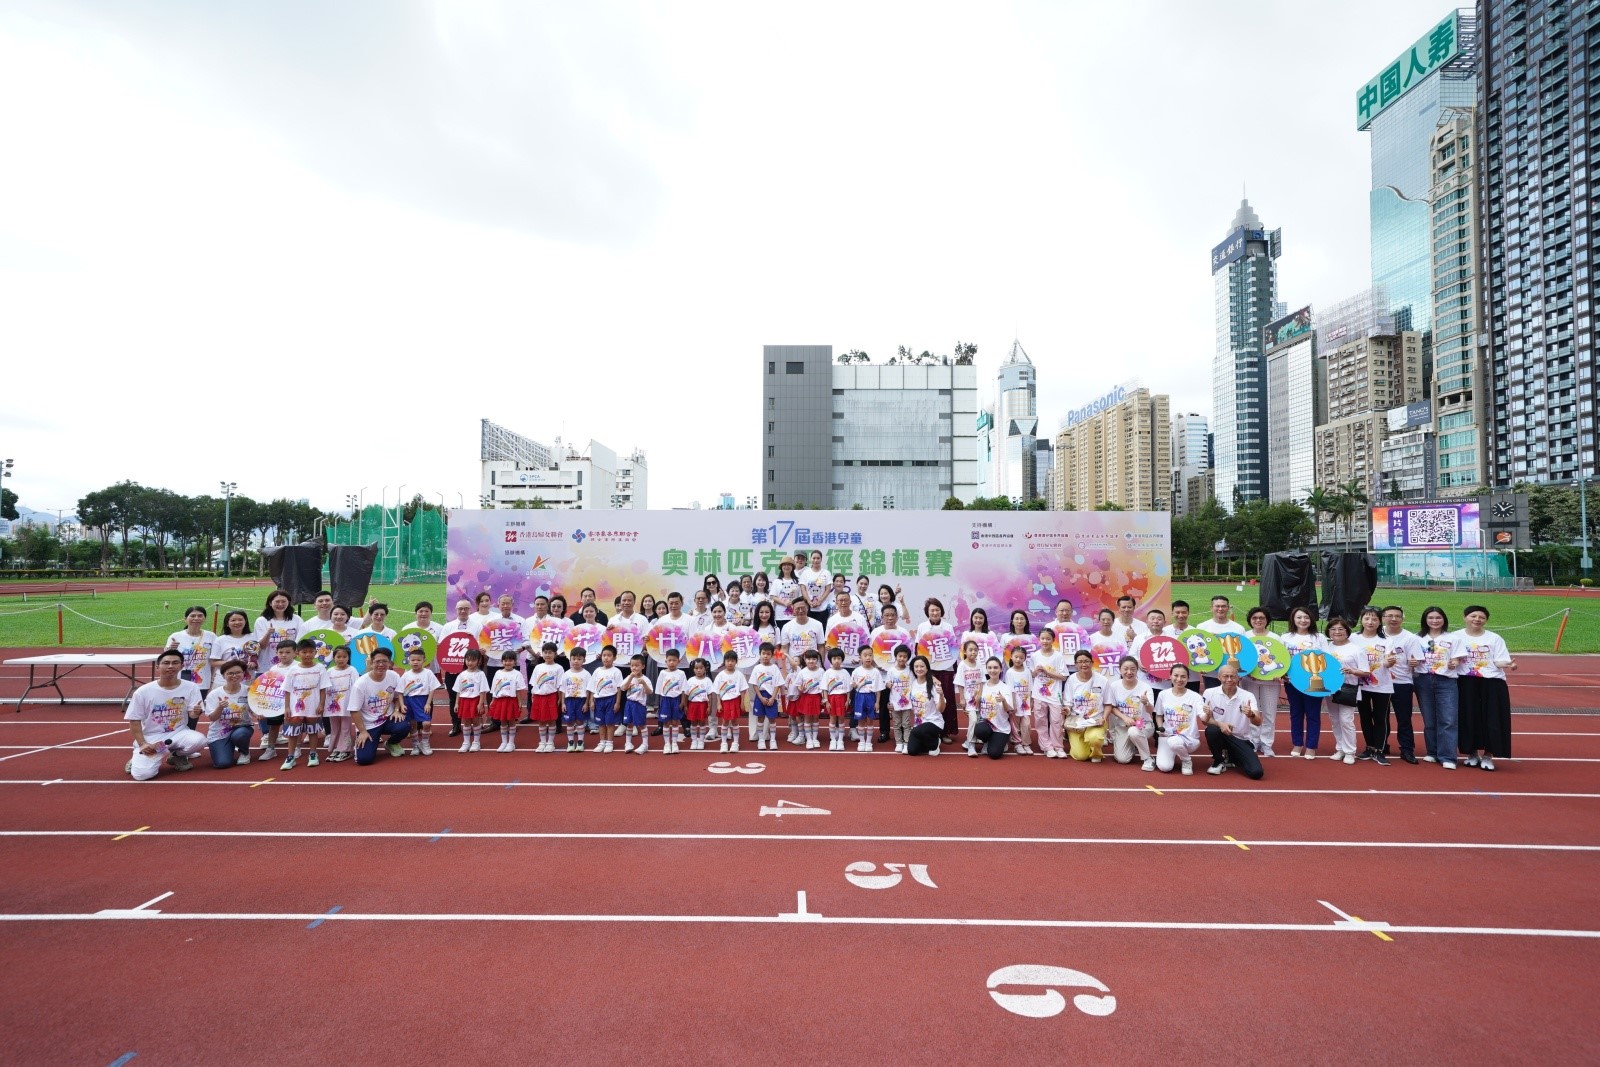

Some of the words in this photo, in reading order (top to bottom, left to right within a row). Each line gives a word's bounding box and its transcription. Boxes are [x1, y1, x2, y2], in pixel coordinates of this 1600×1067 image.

[1359, 18, 1454, 119] 中国人寿
[1067, 384, 1126, 427] Panasonic
[662, 548, 953, 577] 奧林匹克徑錦標賽
[490, 628, 515, 651] 紫
[572, 632, 596, 655] 花
[612, 632, 634, 656] 開
[656, 632, 678, 651] 廿
[732, 636, 756, 659] 載
[837, 632, 860, 656] 親
[881, 639, 903, 663] 子
[926, 637, 953, 663] 運
[1058, 632, 1081, 656] 風
[698, 640, 718, 664] 八
[1097, 651, 1121, 677] 采
[255, 684, 285, 698] 奧林匹
[707, 761, 766, 775] 3
[758, 799, 832, 818] 4
[844, 860, 939, 890] 5
[986, 964, 1117, 1019] 6
